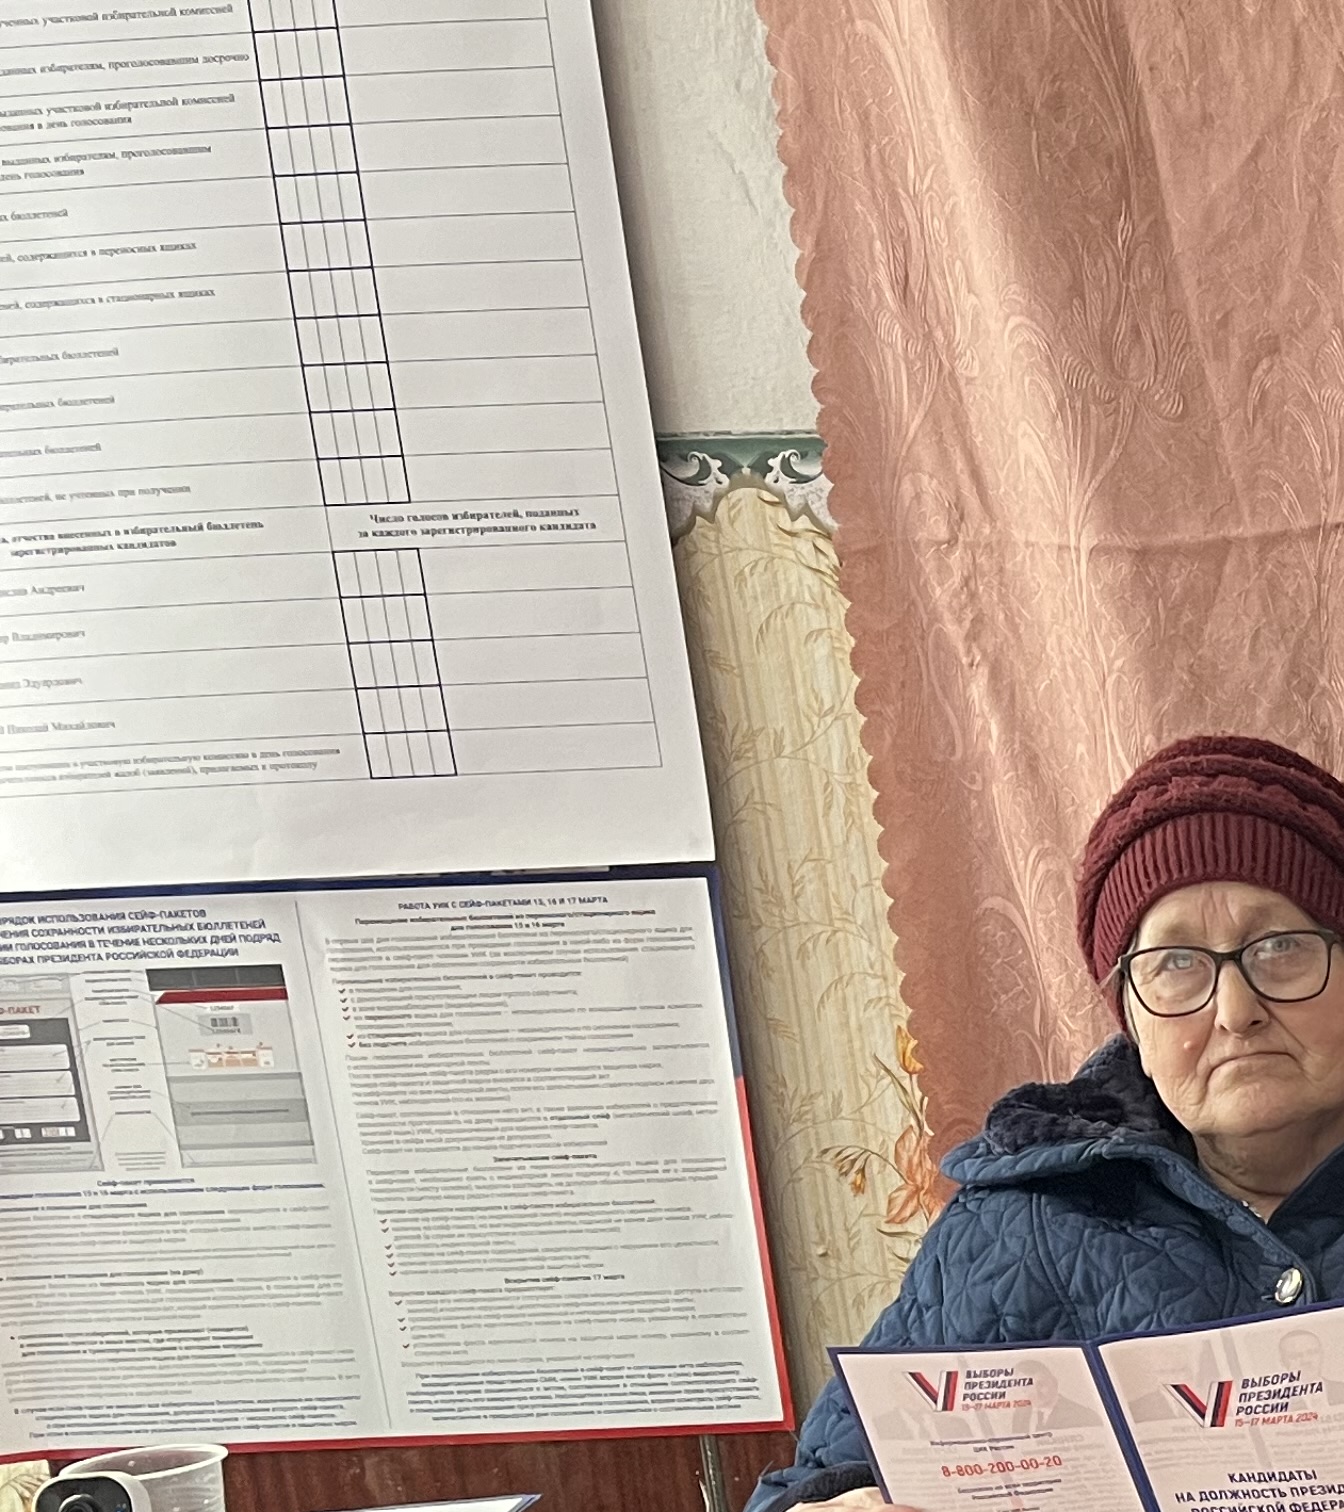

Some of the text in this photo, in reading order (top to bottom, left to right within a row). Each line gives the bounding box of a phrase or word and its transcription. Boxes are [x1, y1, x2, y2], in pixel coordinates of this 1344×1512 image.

[965, 1368, 1014, 1380] ВЫБОРЫ
[1241, 1370, 1301, 1390] ВЫБОРЫ
[964, 1377, 1034, 1390] ПРЕЗИДЕНТА
[962, 1391, 1007, 1402] РОССИИ
[1238, 1381, 1324, 1403] ПРЕЗИДЕНТА
[1235, 1402, 1290, 1417] РОССИИ
[1261, 1414, 1294, 1425] МАРТА
[1295, 1412, 1319, 1423] 2024
[941, 1455, 1063, 1478] 8-800-200-00-20
[1227, 1469, 1318, 1485] КАНДИДАТЫ
[1174, 1491, 1196, 1504] НА
[1199, 1487, 1287, 1503] ДОЛЖНОСТЬ
